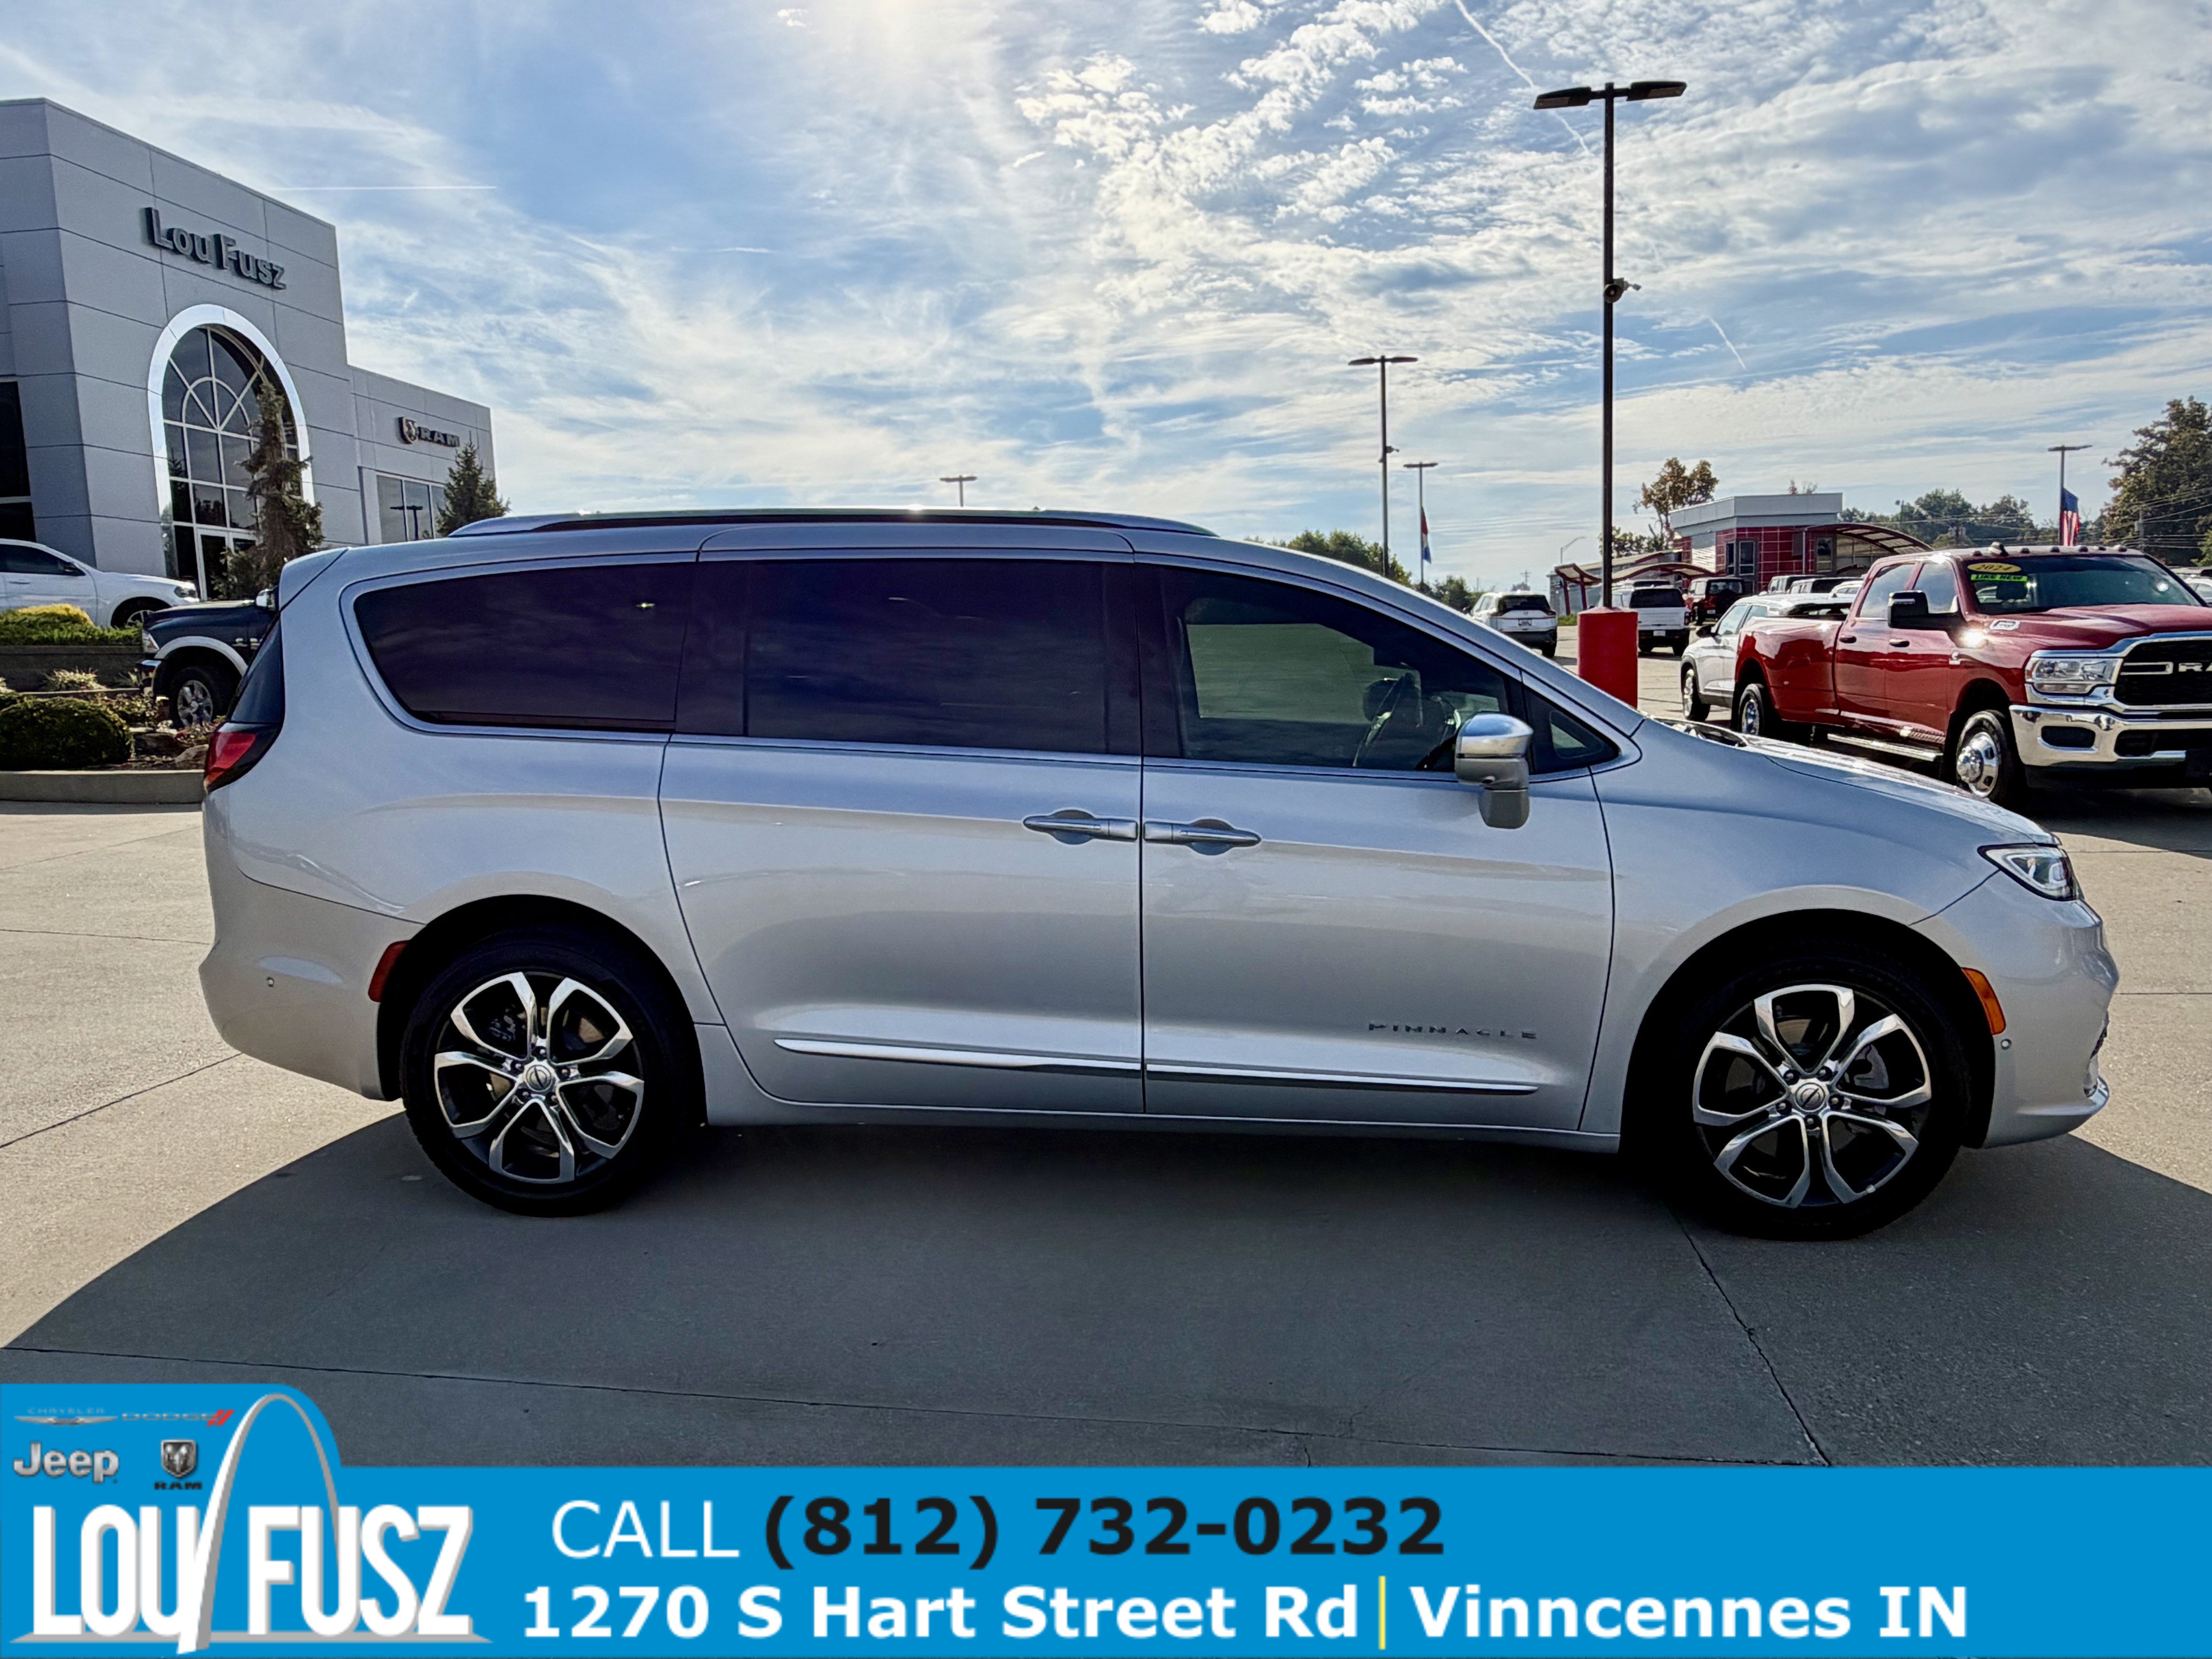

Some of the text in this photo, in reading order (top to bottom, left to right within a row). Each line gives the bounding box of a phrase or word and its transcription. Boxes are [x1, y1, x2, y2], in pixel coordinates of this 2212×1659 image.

[144, 207, 286, 290] Lou Fusz
[417, 426, 460, 447] RAM
[1369, 1023, 1537, 1039] PINNACLE
